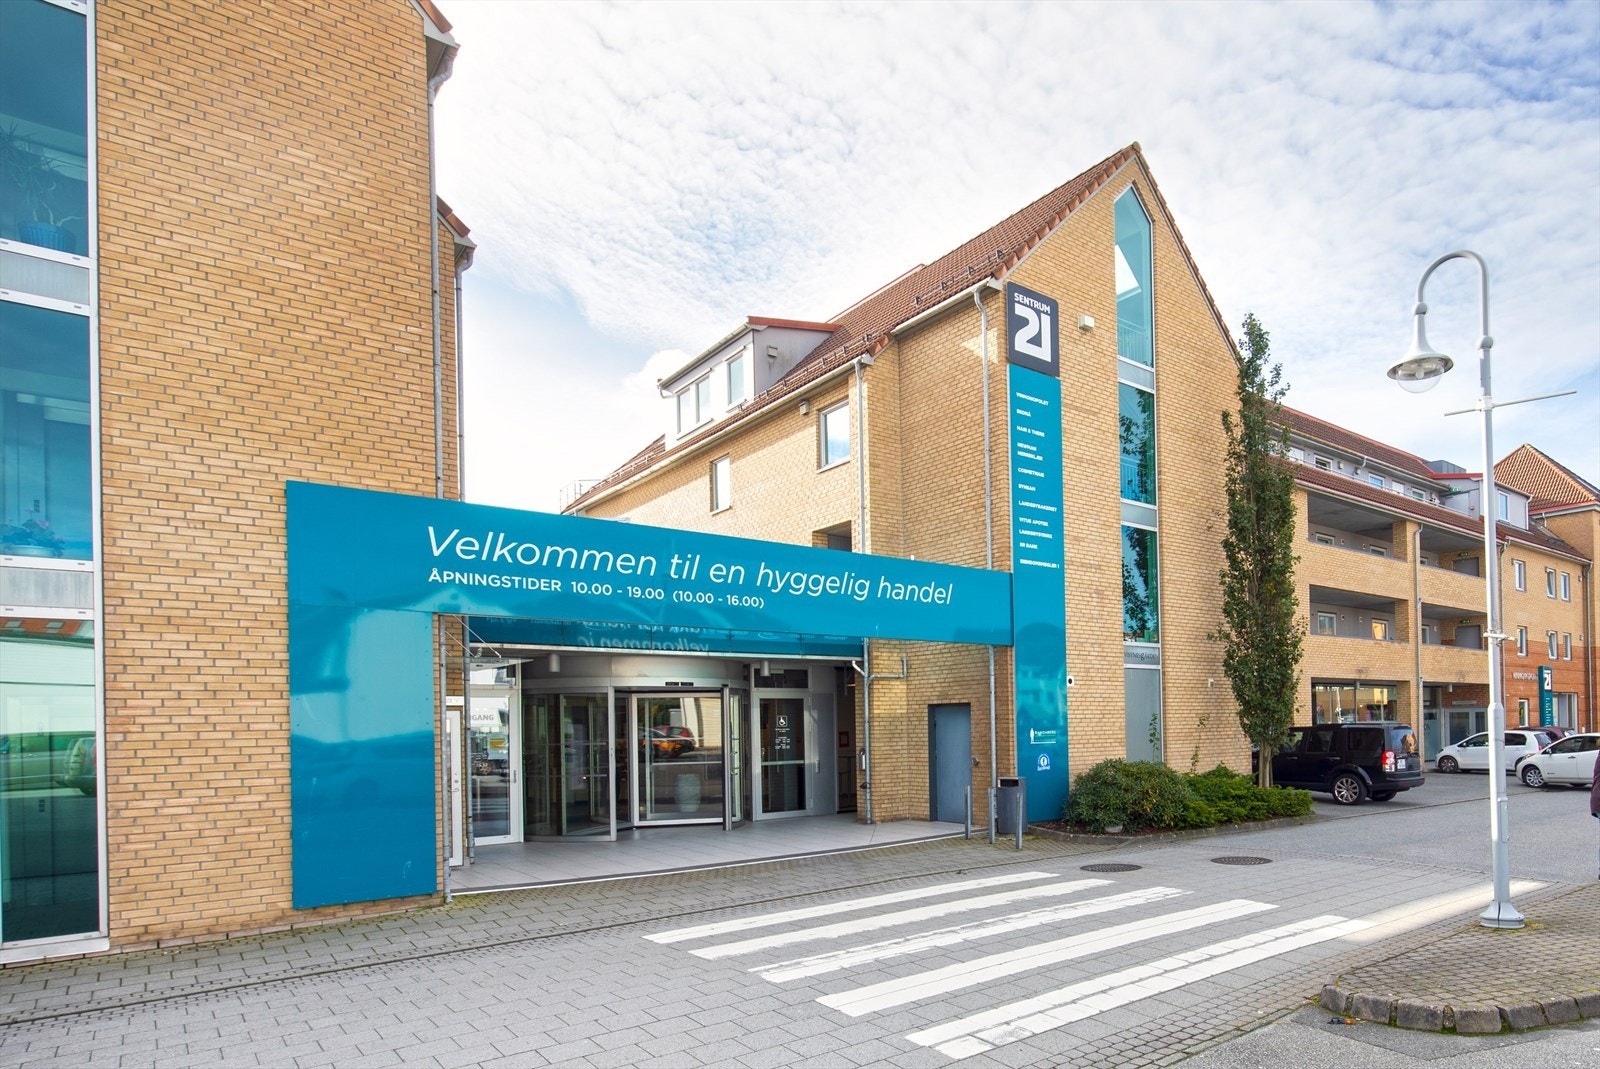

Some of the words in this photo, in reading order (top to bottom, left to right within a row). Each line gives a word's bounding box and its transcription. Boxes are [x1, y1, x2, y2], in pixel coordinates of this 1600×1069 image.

[1014, 293, 1051, 314] SENTRUM
[1014, 302, 1052, 362] 21
[1032, 519, 1049, 527] APOTEK
[428, 526, 656, 576] Velkommen
[670, 554, 700, 580] til
[709, 563, 745, 585] en
[756, 561, 870, 601] hyggelig
[877, 576, 953, 605] handel
[428, 568, 562, 592] ÅPNINGSTIDER
[571, 581, 613, 596] 10.00
[626, 587, 665, 600] 19.00
[672, 591, 714, 604] (10.00
[726, 595, 765, 609] 16.00)
